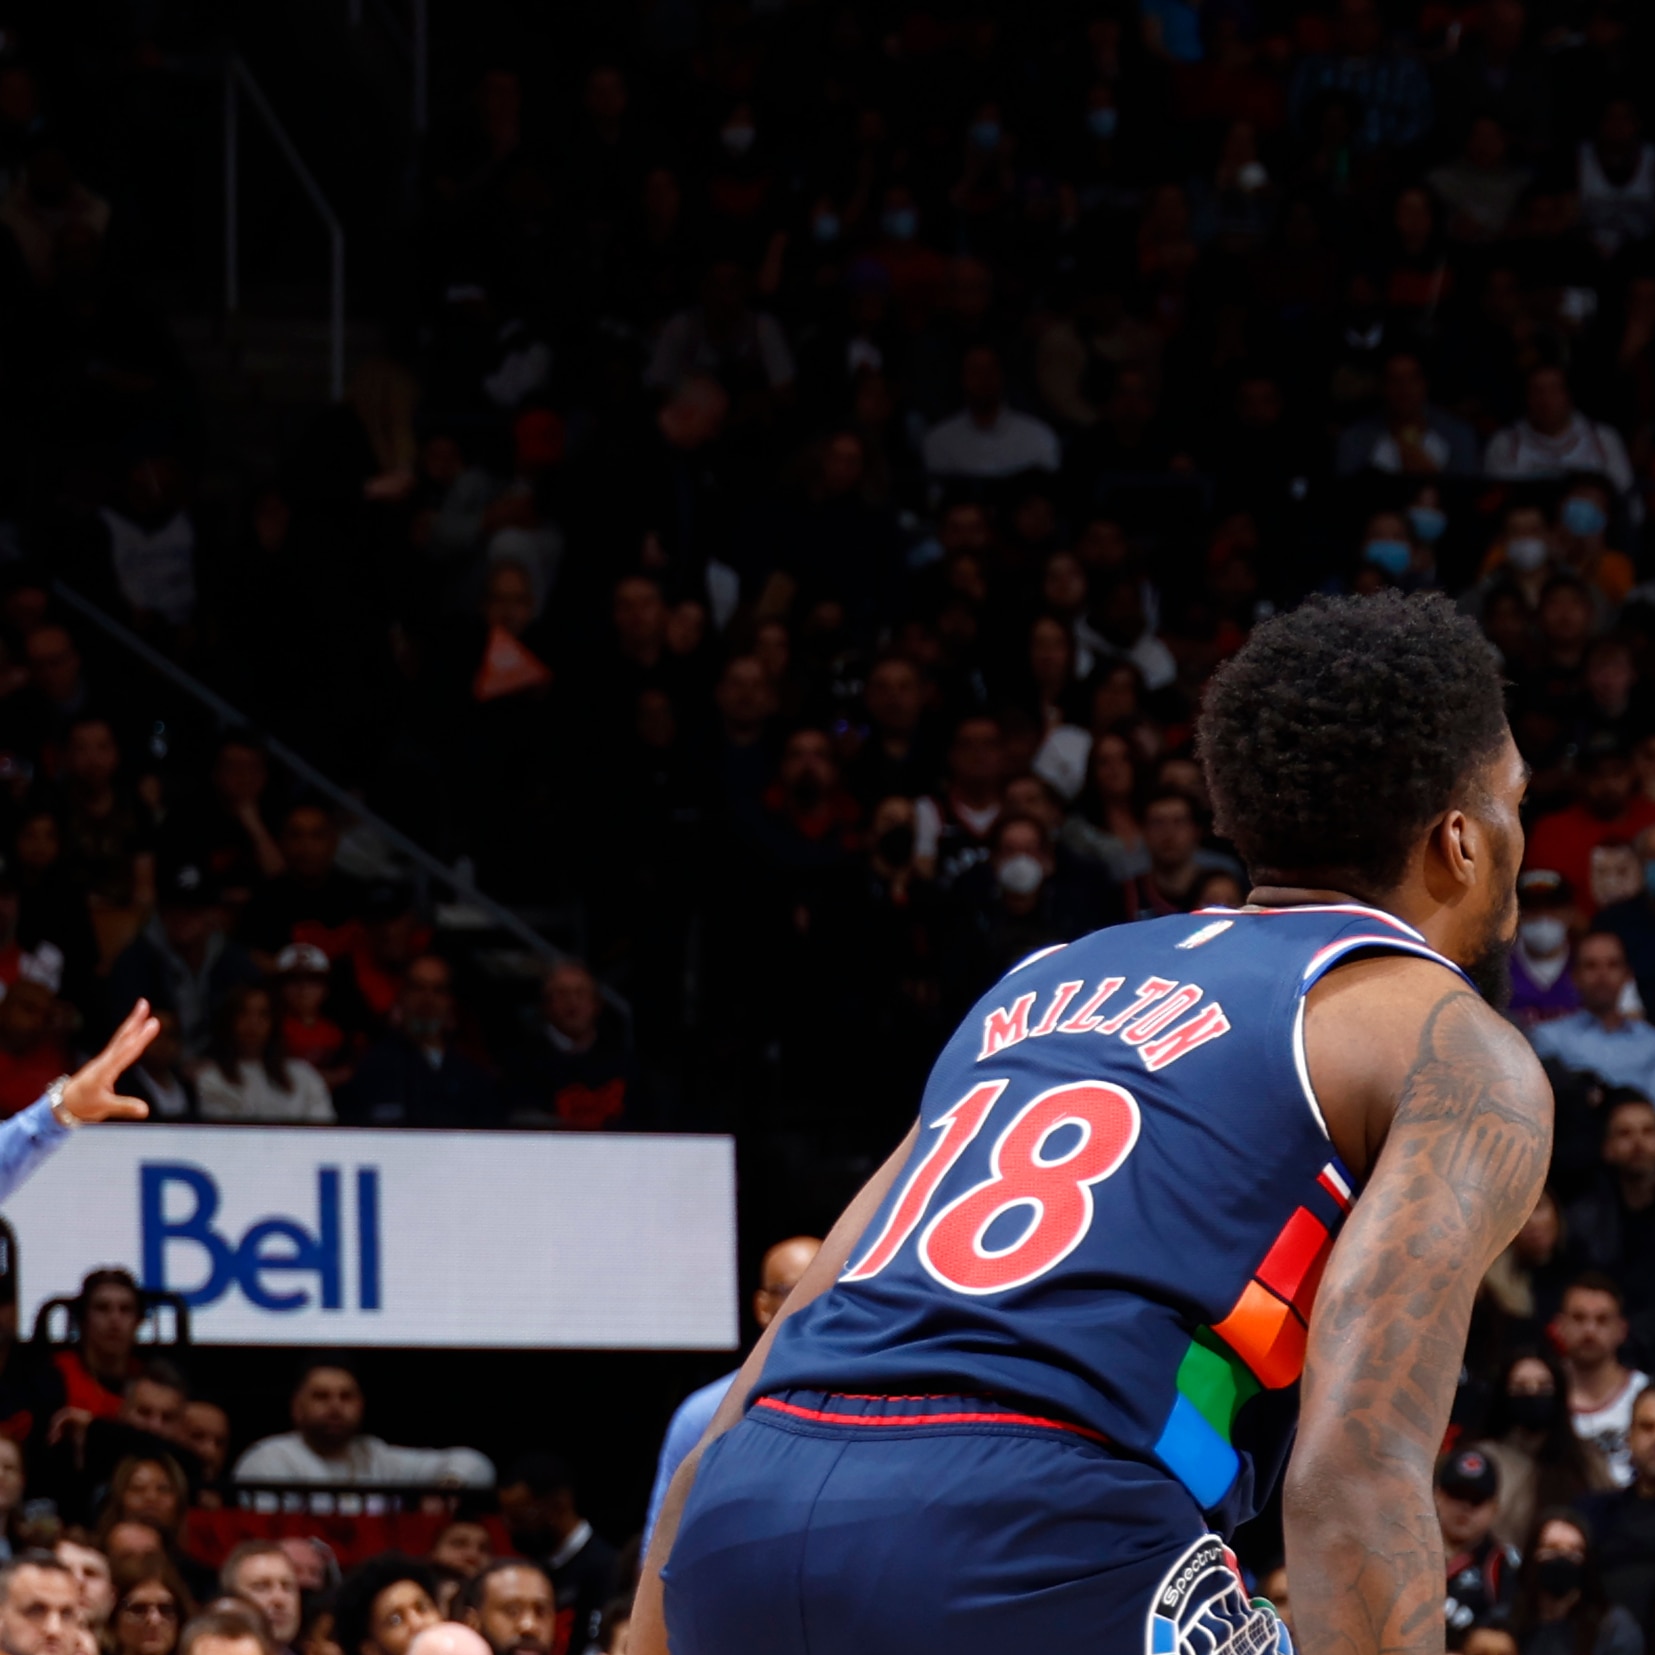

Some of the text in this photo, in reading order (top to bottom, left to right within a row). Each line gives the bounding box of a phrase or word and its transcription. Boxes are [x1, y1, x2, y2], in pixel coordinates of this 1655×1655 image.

[977, 976, 1231, 1072] MILTON
[139, 1160, 381, 1312] Bell
[838, 1078, 1141, 1295] 18
